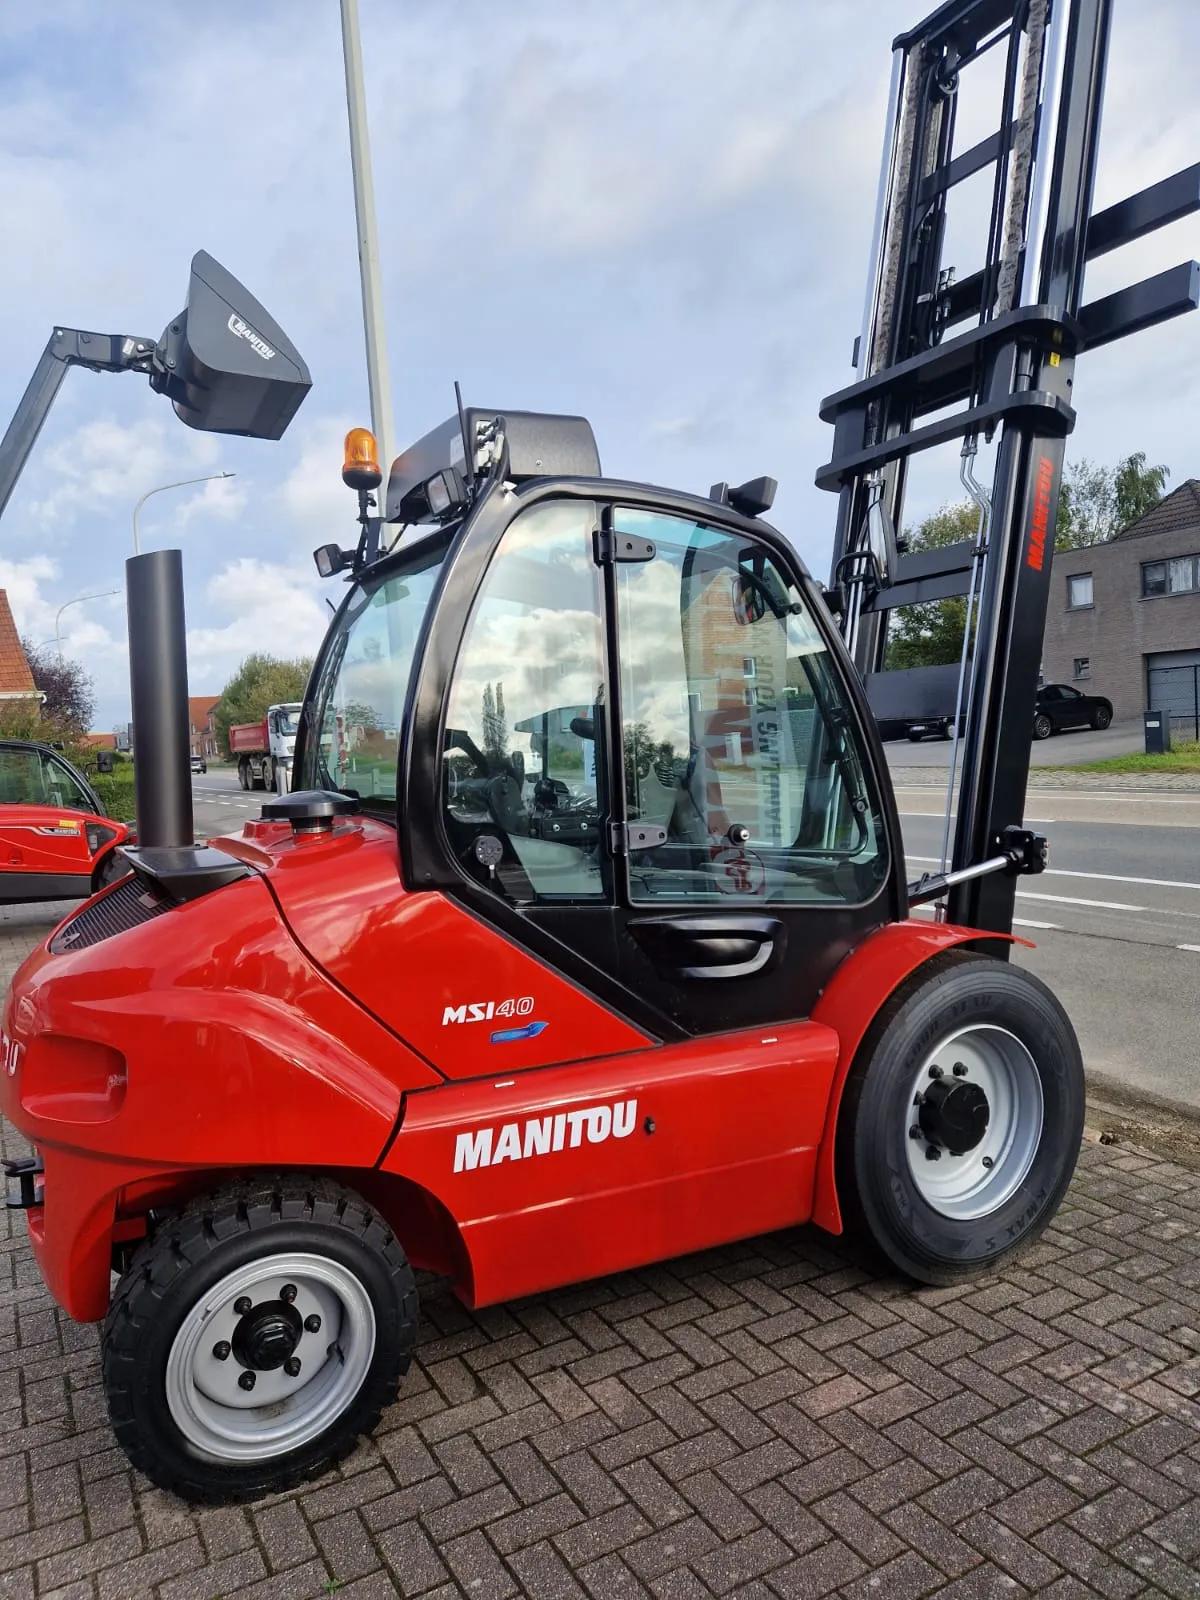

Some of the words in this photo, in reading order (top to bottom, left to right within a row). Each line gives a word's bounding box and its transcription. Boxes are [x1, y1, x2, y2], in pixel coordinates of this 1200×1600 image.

[233, 320, 276, 358] MANITOU
[1026, 457, 1054, 571] MANITOU
[755, 655, 777, 715] YOUR
[756, 721, 782, 839] HANDLING
[441, 996, 535, 1026] MSI40
[453, 1099, 638, 1173] MANITOU
